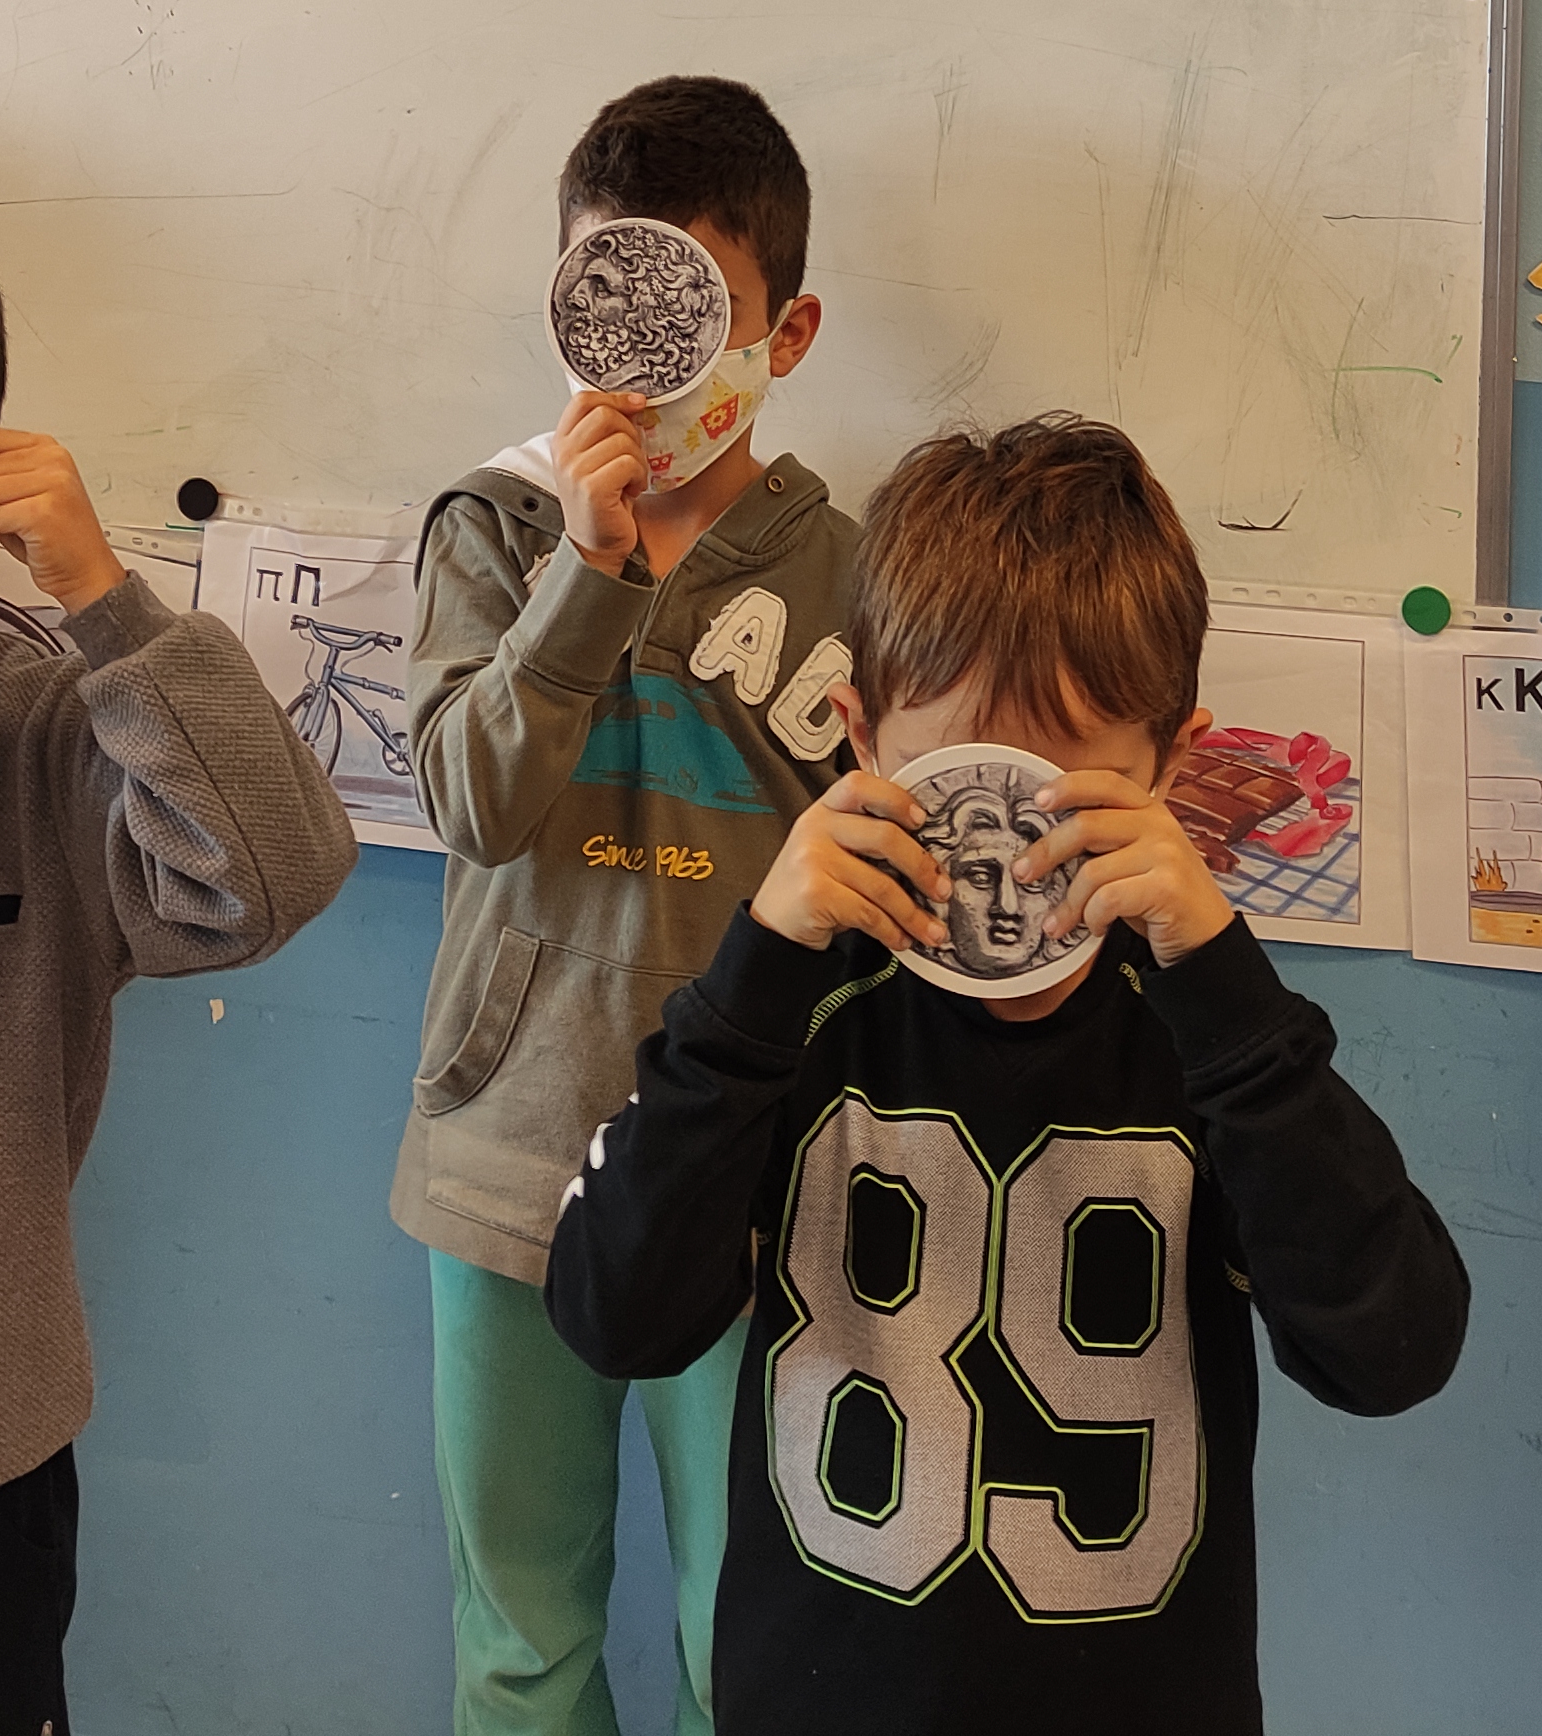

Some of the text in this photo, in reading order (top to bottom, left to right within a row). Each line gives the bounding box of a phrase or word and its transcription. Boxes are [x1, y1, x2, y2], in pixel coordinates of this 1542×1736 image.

[581, 834, 715, 881] Since 1963
[765, 1086, 1207, 1624] 89
